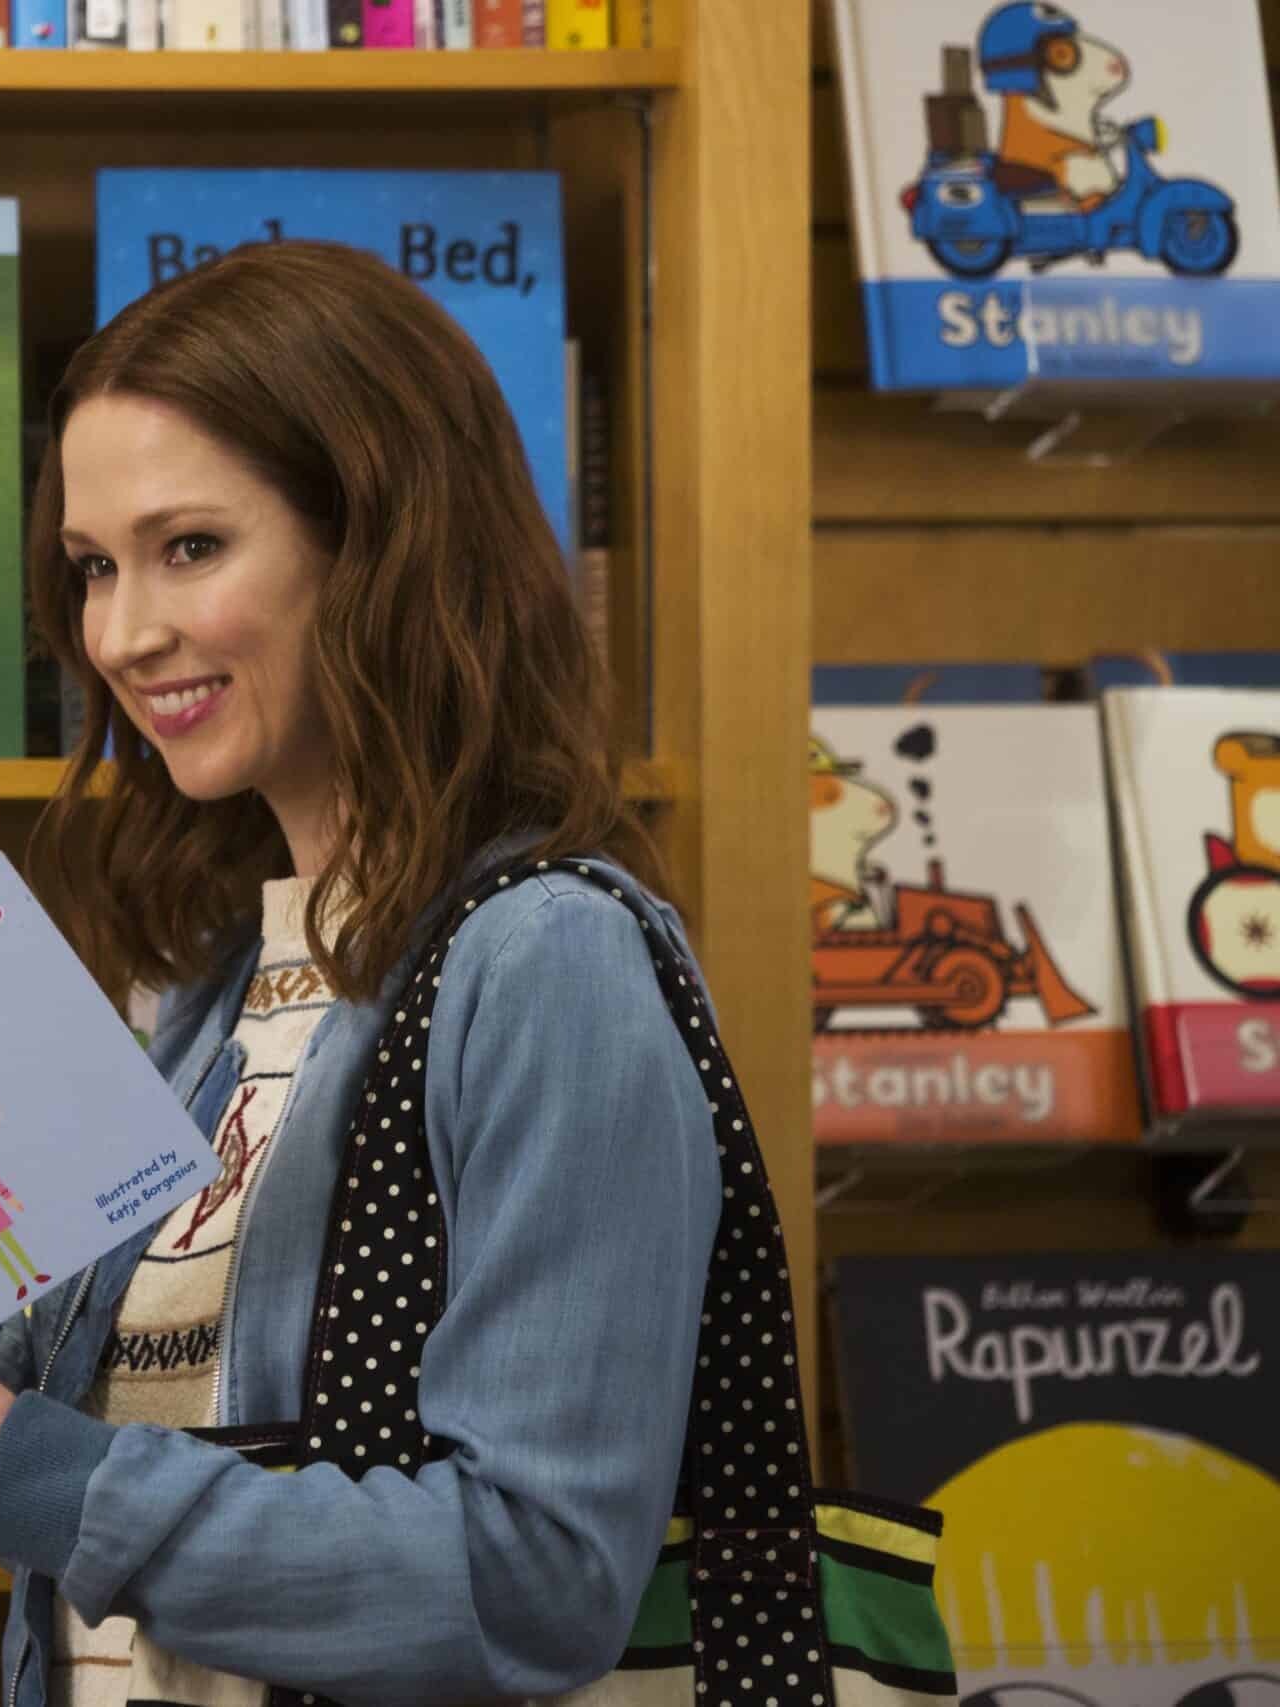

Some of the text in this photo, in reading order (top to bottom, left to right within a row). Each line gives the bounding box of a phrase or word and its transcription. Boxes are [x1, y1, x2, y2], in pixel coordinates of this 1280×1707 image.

[400, 222, 538, 296] Bed,
[937, 289, 1204, 367] Stanley
[95, 1149, 177, 1209] Illustrated by
[106, 1159, 198, 1225] Katje Borgesius
[923, 1281, 1262, 1425] Rapunzel
